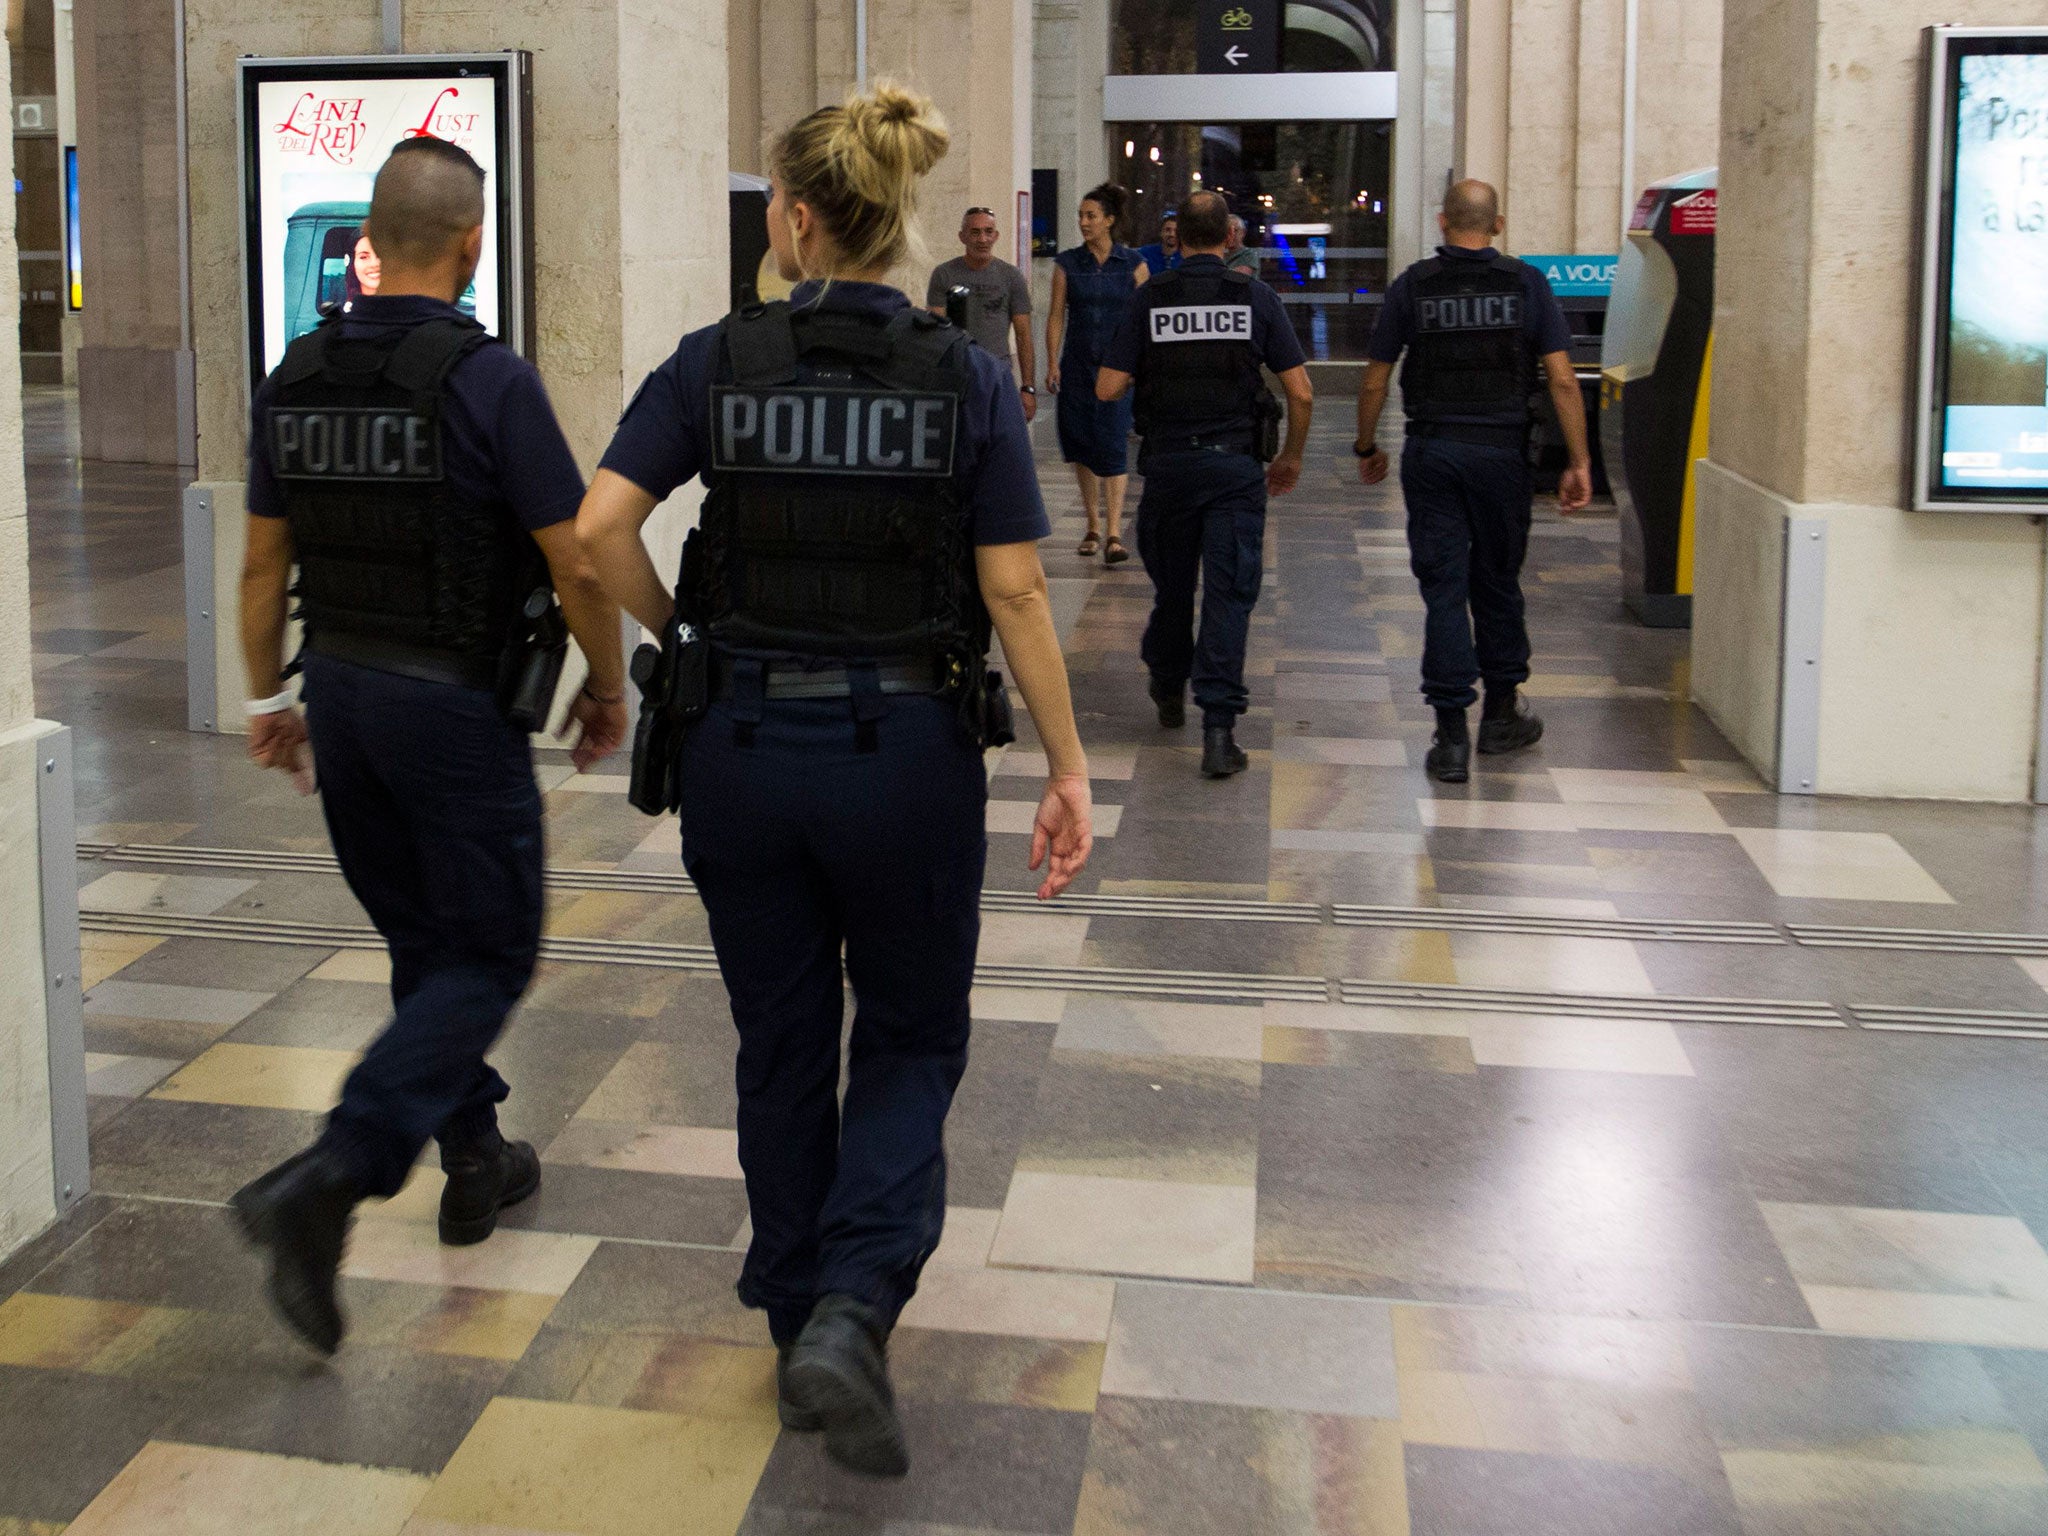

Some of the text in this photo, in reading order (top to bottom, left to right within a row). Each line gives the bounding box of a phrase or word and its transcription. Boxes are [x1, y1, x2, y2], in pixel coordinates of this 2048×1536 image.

[273, 92, 366, 136] LANA
[403, 87, 479, 142] LUST
[279, 122, 366, 165] DEL REY
[1565, 264, 1618, 281] VOUS
[1155, 311, 1247, 336] POLICE
[1421, 296, 1519, 329] POLICE
[275, 414, 433, 474] POLICE
[722, 394, 944, 469] POLICE
